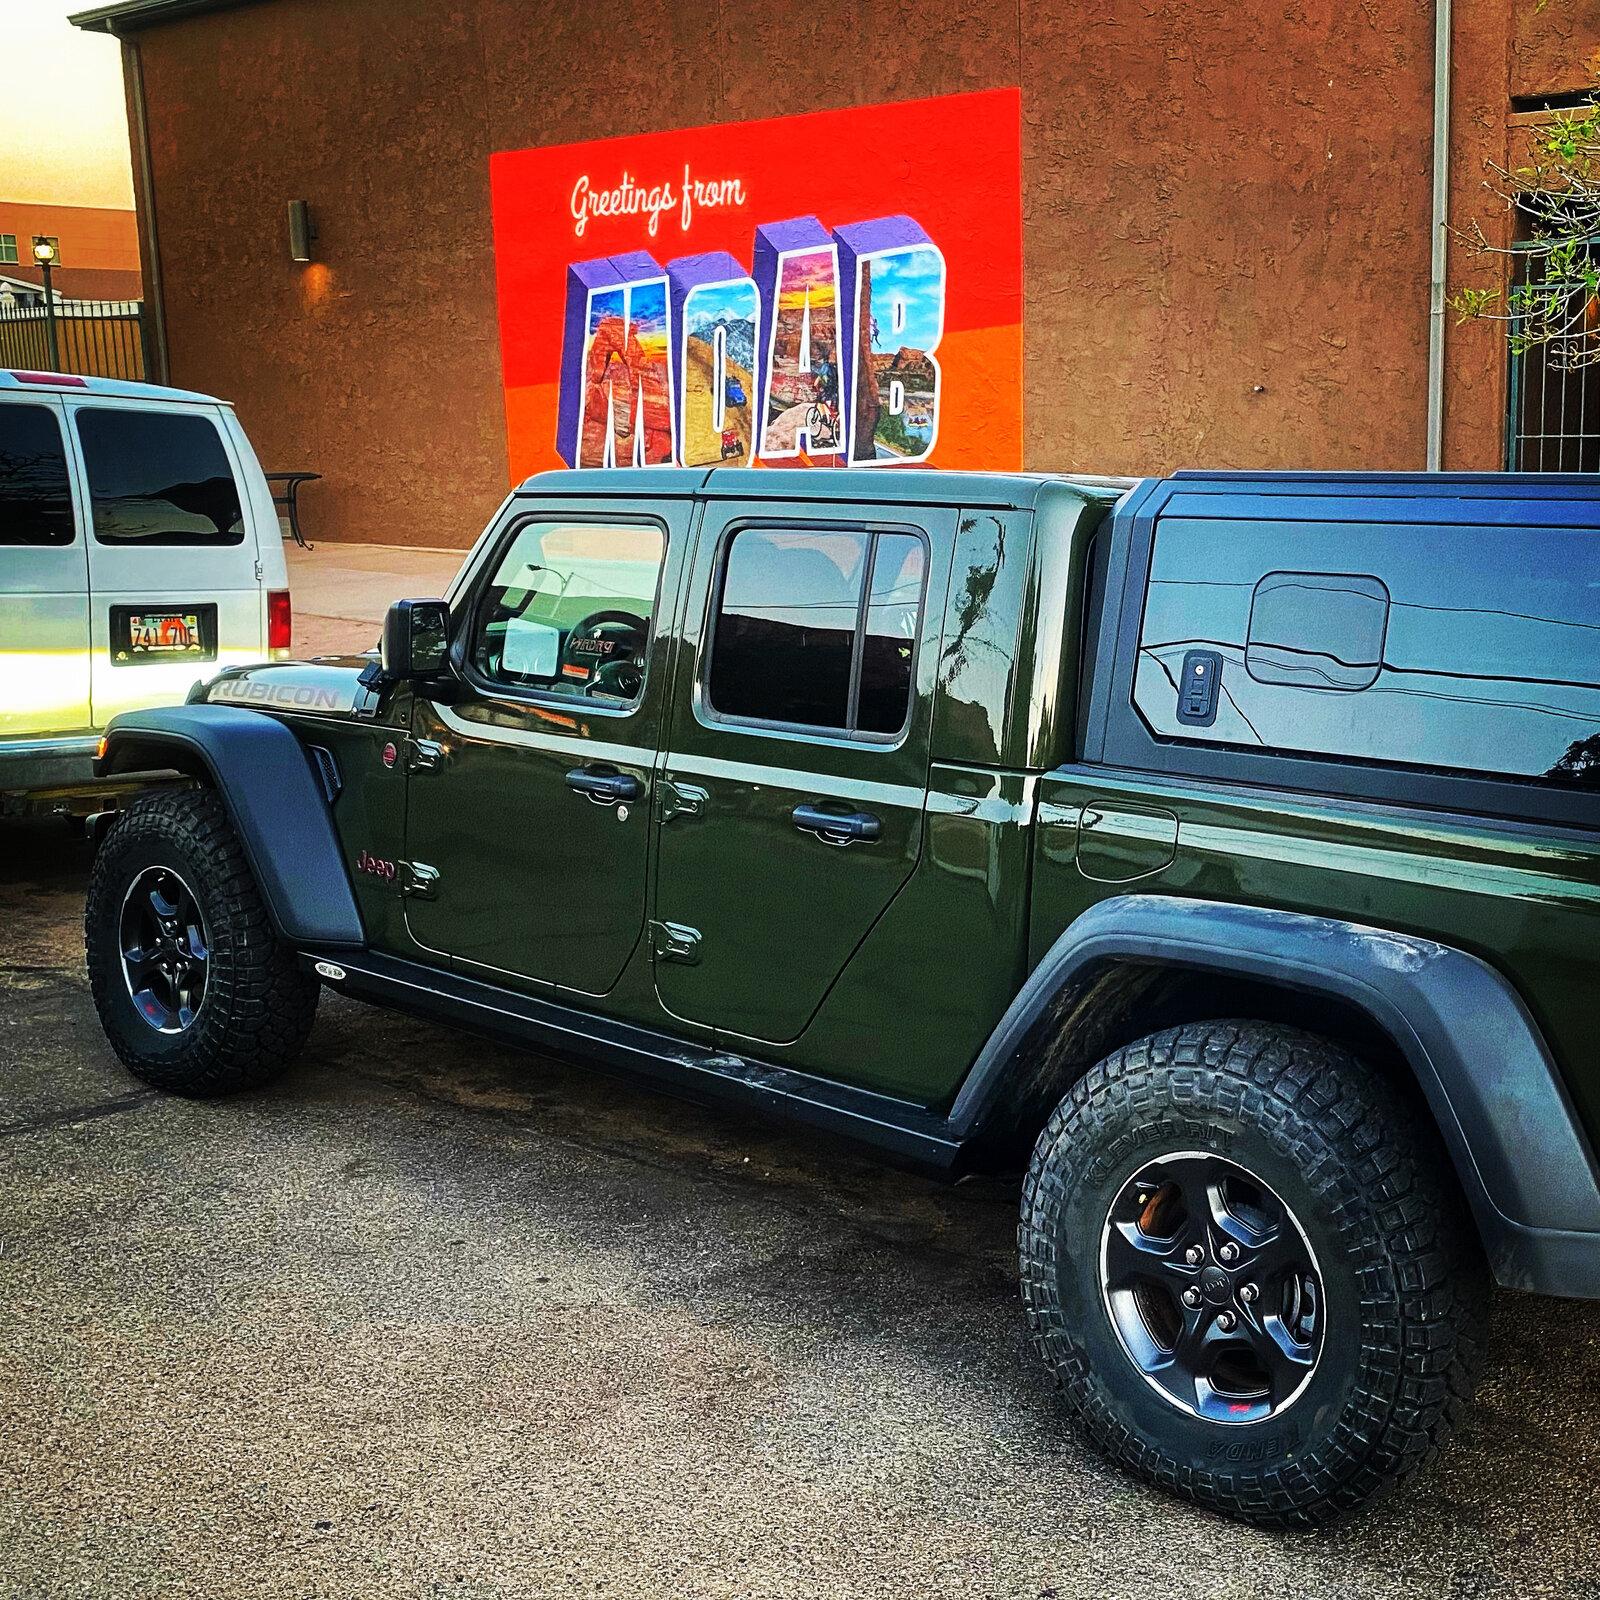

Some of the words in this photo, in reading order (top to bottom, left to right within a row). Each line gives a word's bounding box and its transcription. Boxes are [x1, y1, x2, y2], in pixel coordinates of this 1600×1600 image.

[571, 171, 677, 237] Greetings
[682, 164, 746, 231] from
[564, 228, 946, 468] MOAB
[213, 681, 340, 709] RUBICON
[356, 849, 395, 881] Jeep
[1083, 1119, 1176, 1182] KLEVER
